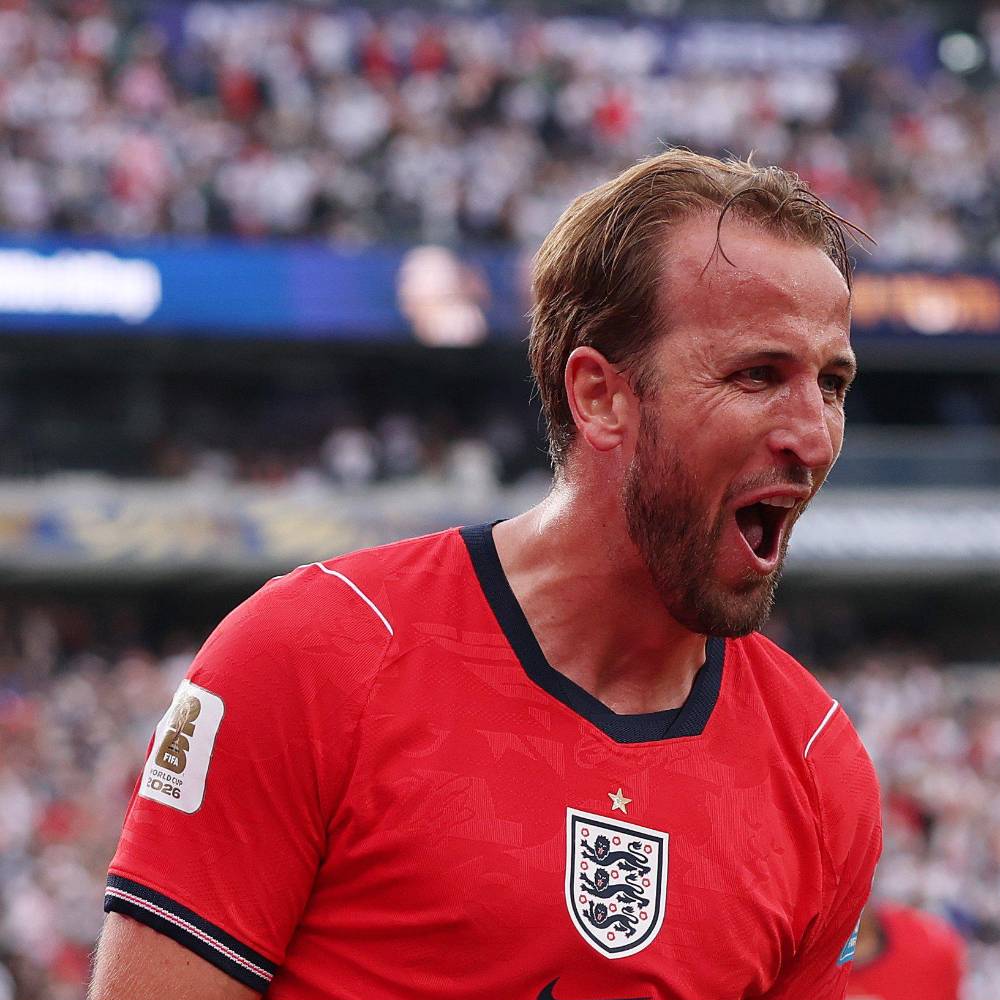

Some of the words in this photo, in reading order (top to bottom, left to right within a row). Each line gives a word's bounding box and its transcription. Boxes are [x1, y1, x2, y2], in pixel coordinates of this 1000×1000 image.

[163, 752, 180, 767] FIFA
[146, 777, 181, 800] 2026
[172, 776, 184, 787] CUP
